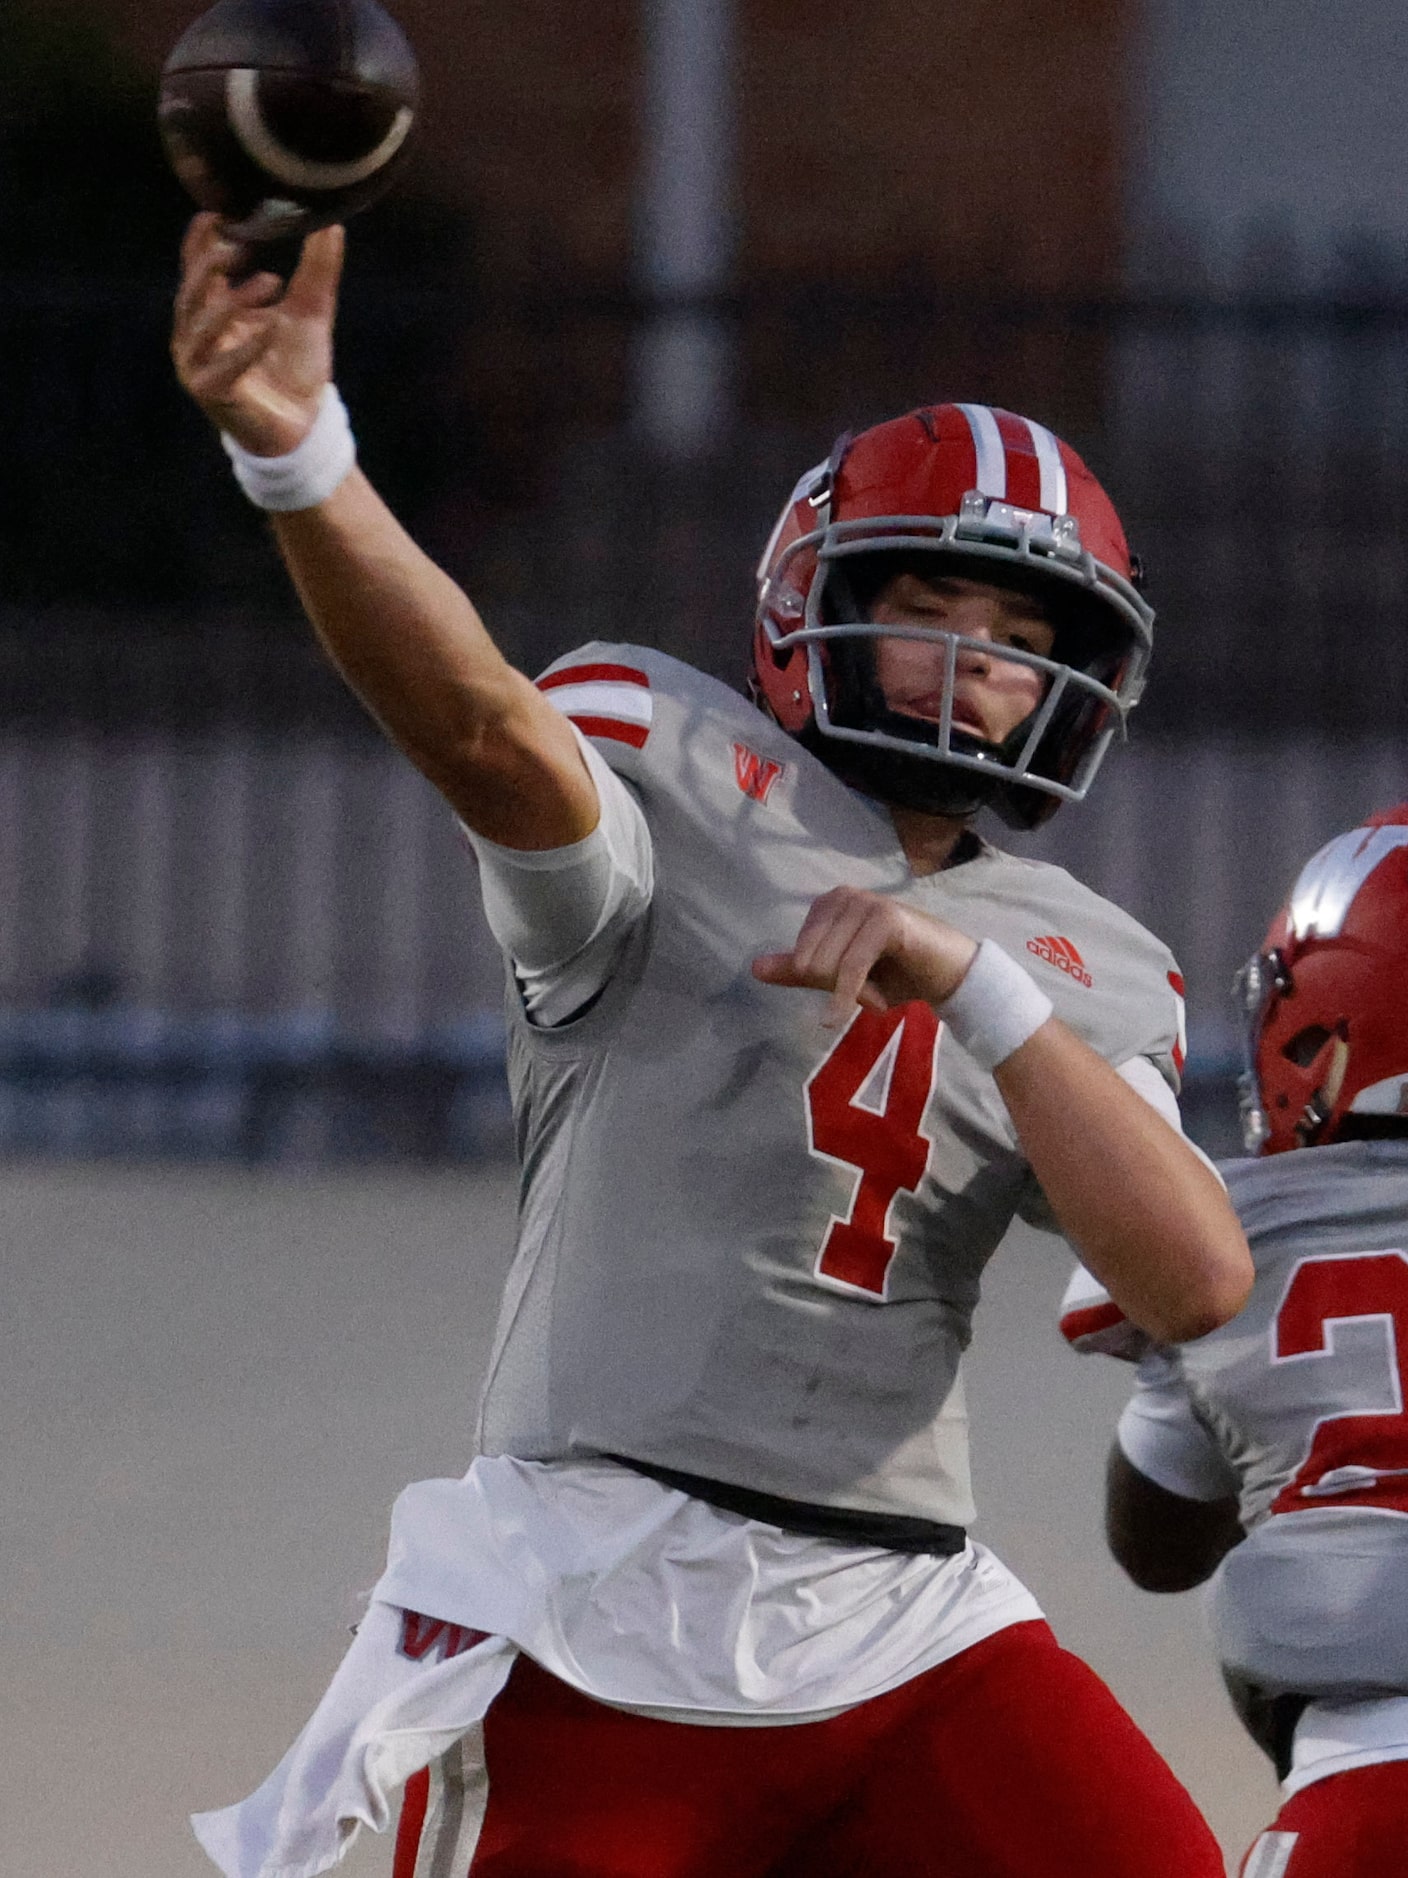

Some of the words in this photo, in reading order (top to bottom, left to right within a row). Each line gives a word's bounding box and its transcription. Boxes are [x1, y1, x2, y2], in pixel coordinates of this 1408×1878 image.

[733, 742, 781, 806] W
[1026, 938, 1092, 988] adidas
[803, 999, 942, 1303] 4
